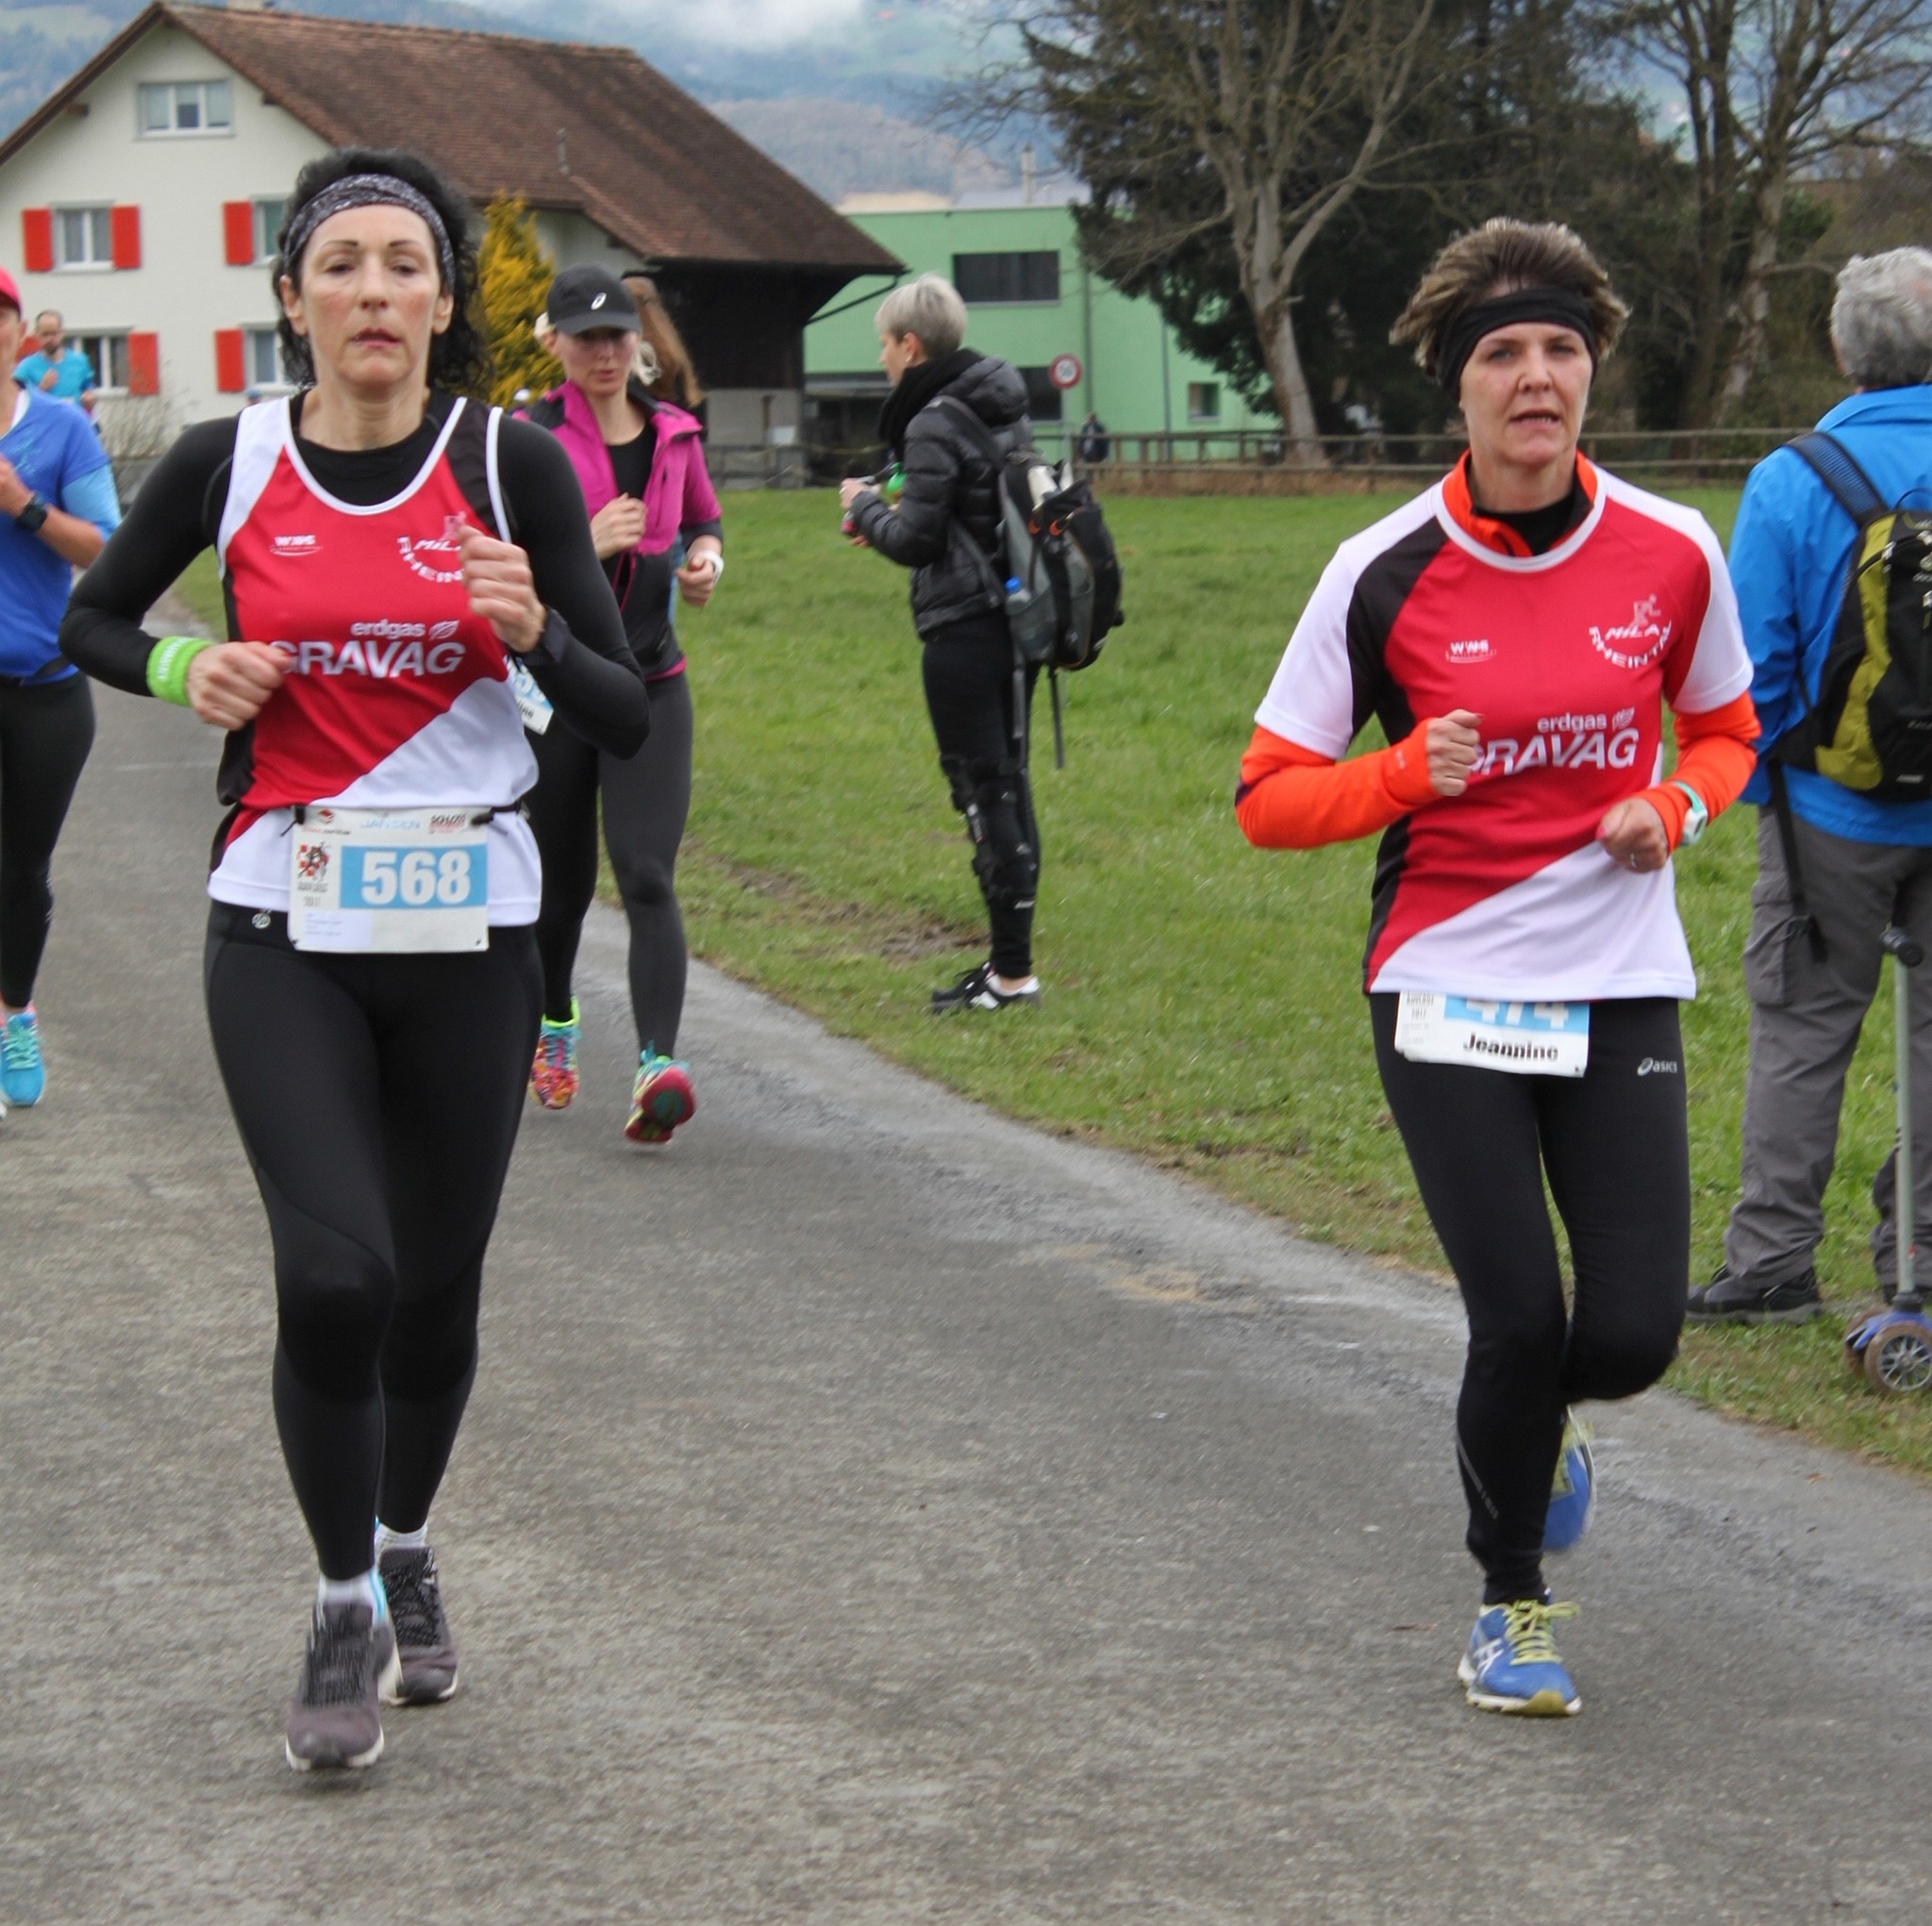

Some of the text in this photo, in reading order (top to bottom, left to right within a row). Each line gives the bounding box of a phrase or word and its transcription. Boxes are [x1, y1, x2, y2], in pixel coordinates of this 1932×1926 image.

[350, 619, 425, 639] erdgas
[1605, 623, 1660, 641] MILA
[1589, 620, 1673, 669] RHEINTAL
[1537, 711, 1607, 733] erdgas
[360, 850, 471, 905] 568
[1463, 1033, 1559, 1061] Jeannine
